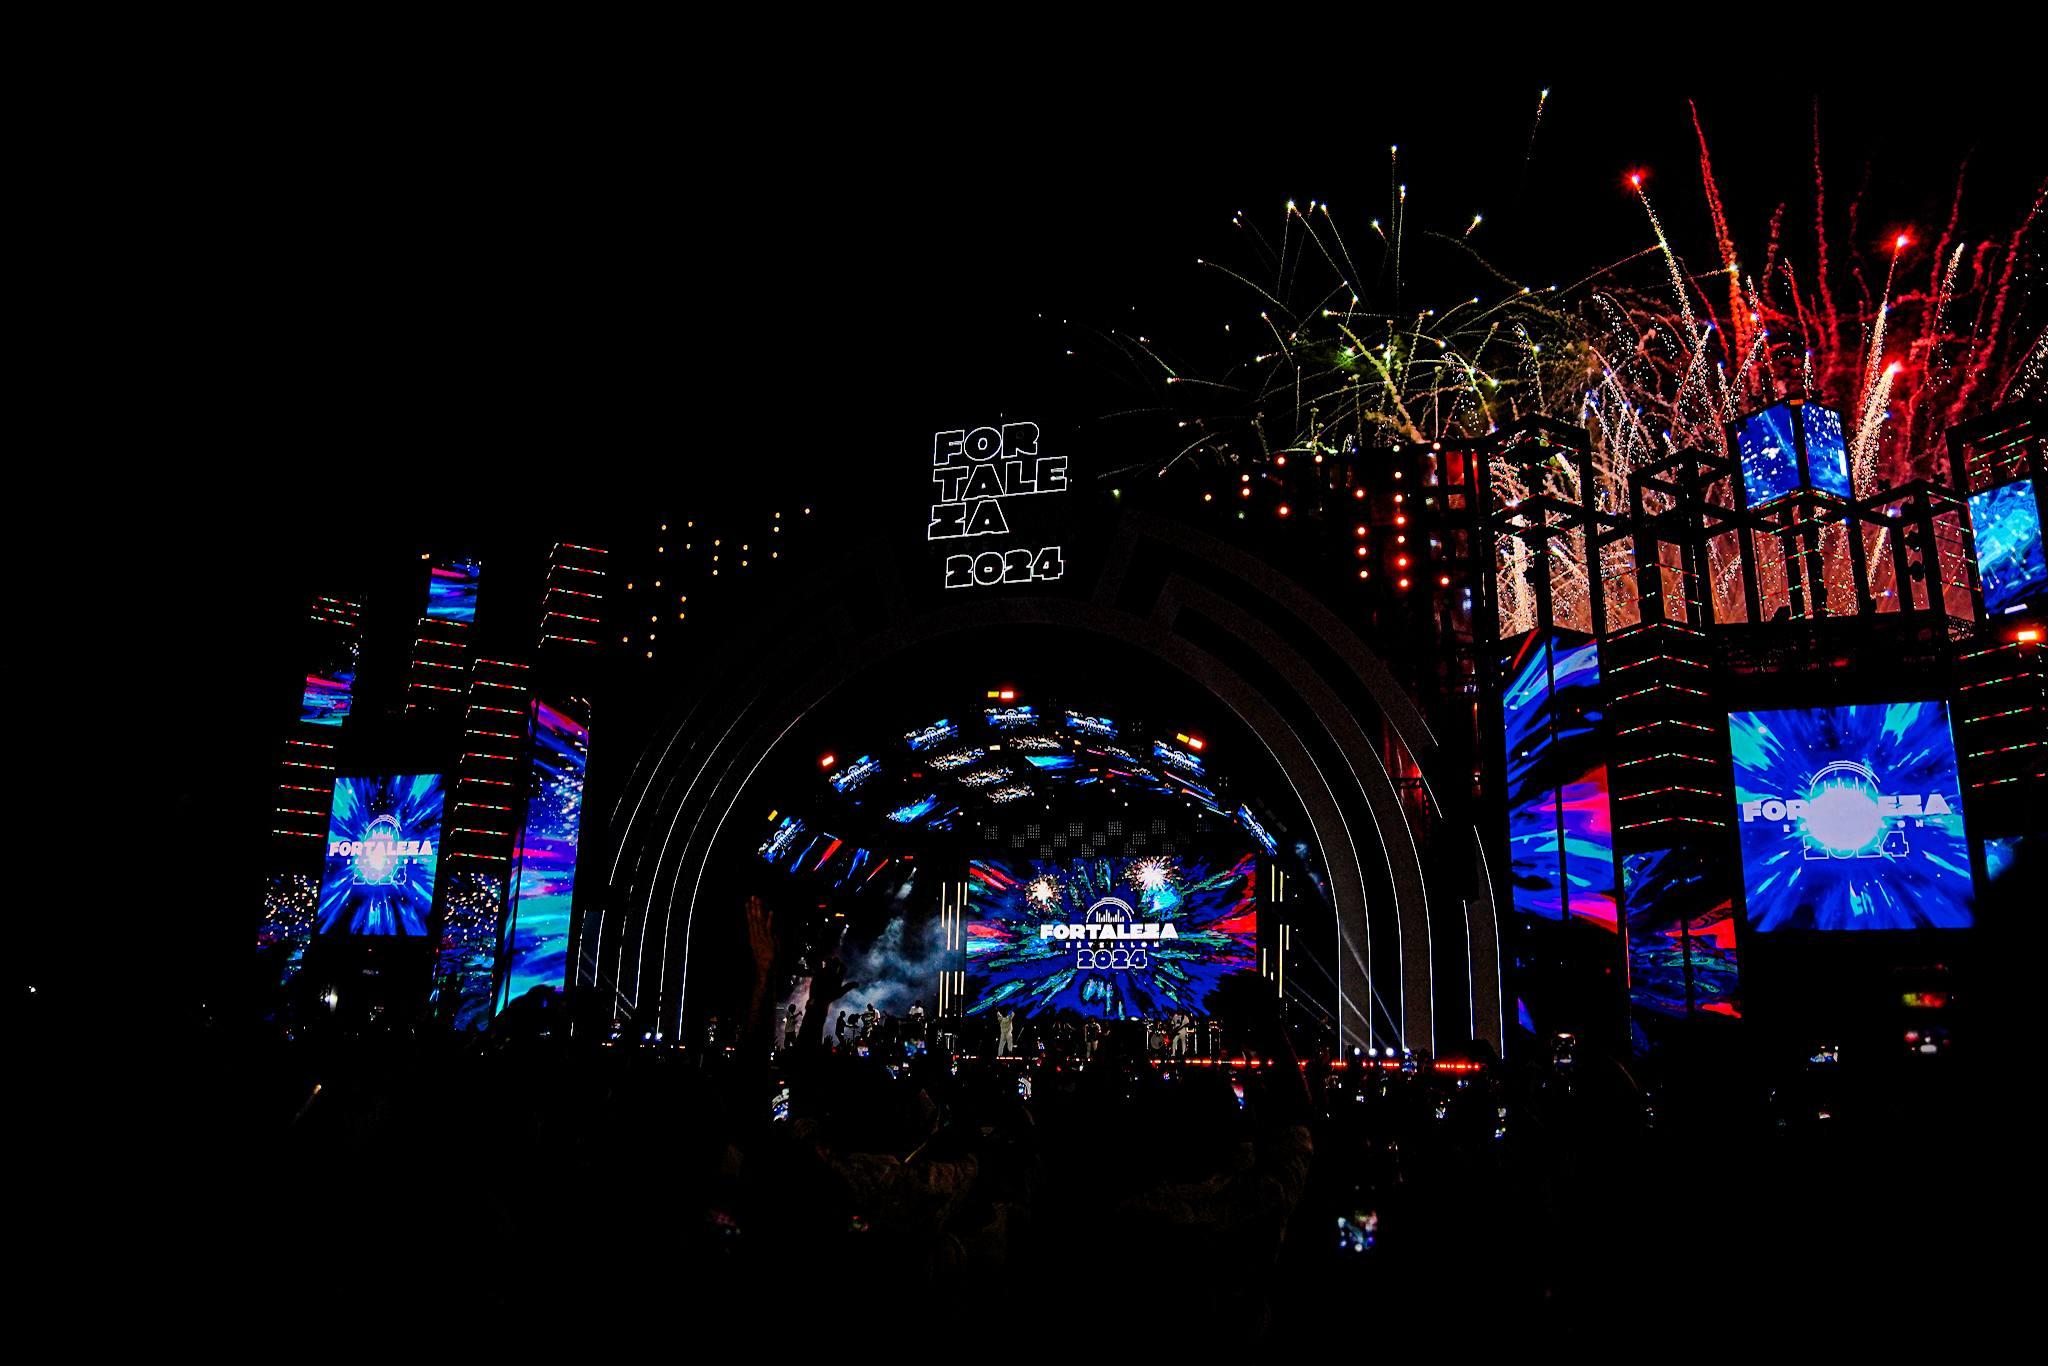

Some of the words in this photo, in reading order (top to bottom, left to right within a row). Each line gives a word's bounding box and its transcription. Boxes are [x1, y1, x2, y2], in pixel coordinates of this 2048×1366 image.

[933, 422, 1040, 466] FOR
[932, 456, 1068, 502] TALE
[928, 499, 1010, 541] ZA
[945, 546, 1064, 589] 2024
[328, 840, 433, 857] FORTALEZA
[1040, 923, 1179, 940] FORTALEZA
[1077, 949, 1148, 969] 2024
